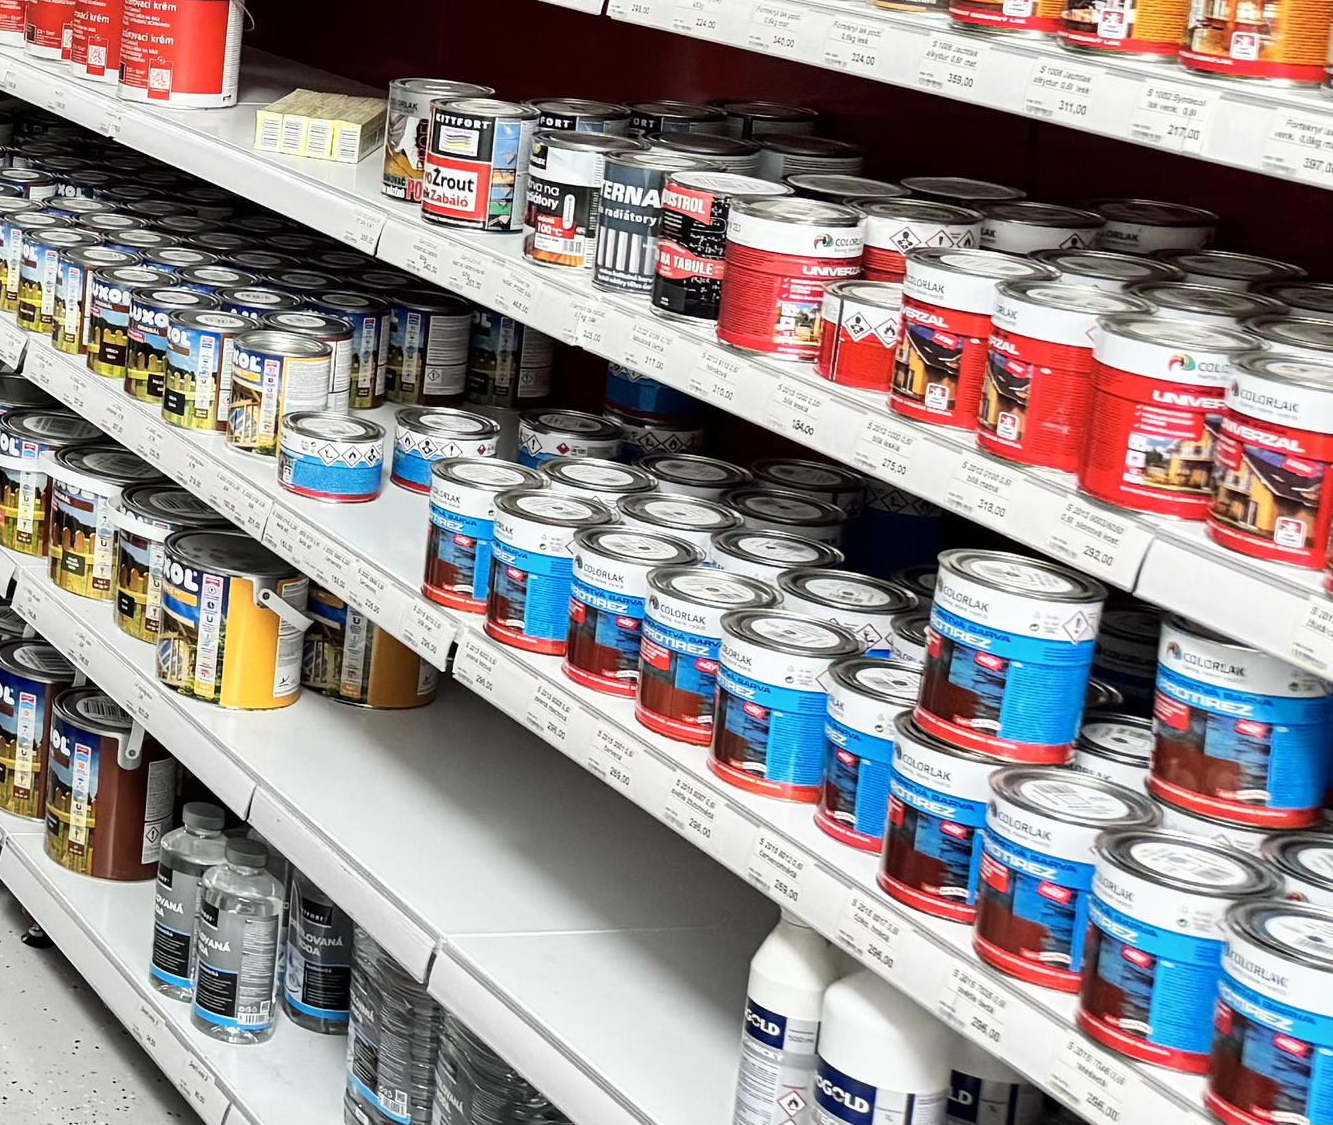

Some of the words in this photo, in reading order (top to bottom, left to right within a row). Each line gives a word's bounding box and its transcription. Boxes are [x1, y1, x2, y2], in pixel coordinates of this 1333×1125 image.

[1058, 100, 1087, 116] 311,00
[435, 114, 491, 130] KITTFORT
[541, 116, 572, 129] FORT
[603, 180, 662, 209] ERNA
[605, 206, 656, 227] radiátory
[672, 255, 713, 275] TABULE
[904, 306, 949, 329] VERZAL
[1153, 390, 1228, 410] UNIVER
[1240, 388, 1301, 413] COLORLAK
[584, 564, 624, 584] COLORLAK
[943, 584, 989, 613] COLORLAK
[660, 603, 707, 625] COLORLAK
[1183, 652, 1246, 678] COLORLAK
[902, 753, 951, 783] COLORLAK
[998, 812, 1052, 841] COLORLAK
